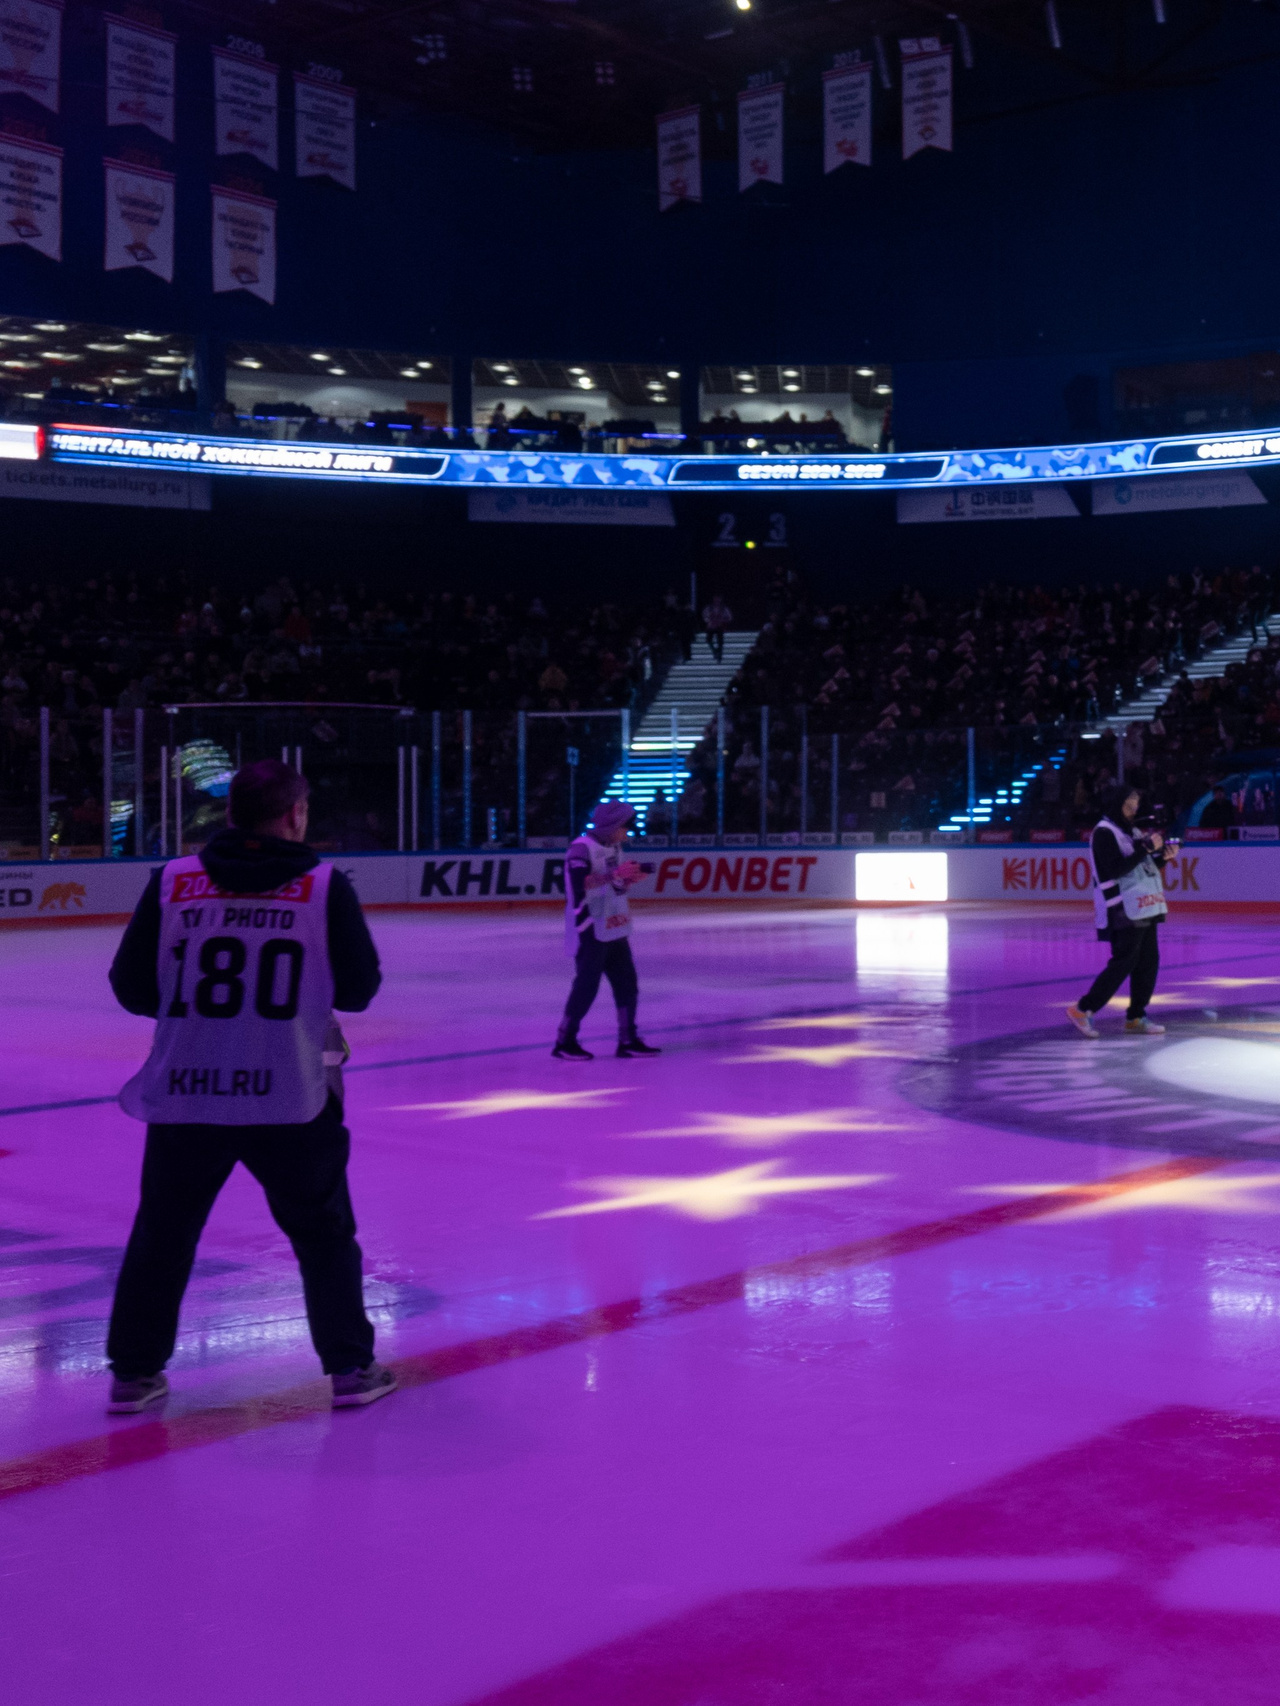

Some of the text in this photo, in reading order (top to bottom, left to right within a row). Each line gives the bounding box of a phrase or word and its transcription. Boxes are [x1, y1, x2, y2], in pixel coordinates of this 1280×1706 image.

[5, 469, 182, 496] tickets.metallurg.ru
[717, 512, 788, 541] 2 3
[420, 857, 817, 897] KHL.R FONBET
[1002, 857, 1200, 891] КИНОСК
[180, 908, 204, 928] TV
[223, 907, 296, 930] PHOTO
[167, 936, 304, 1021] 180
